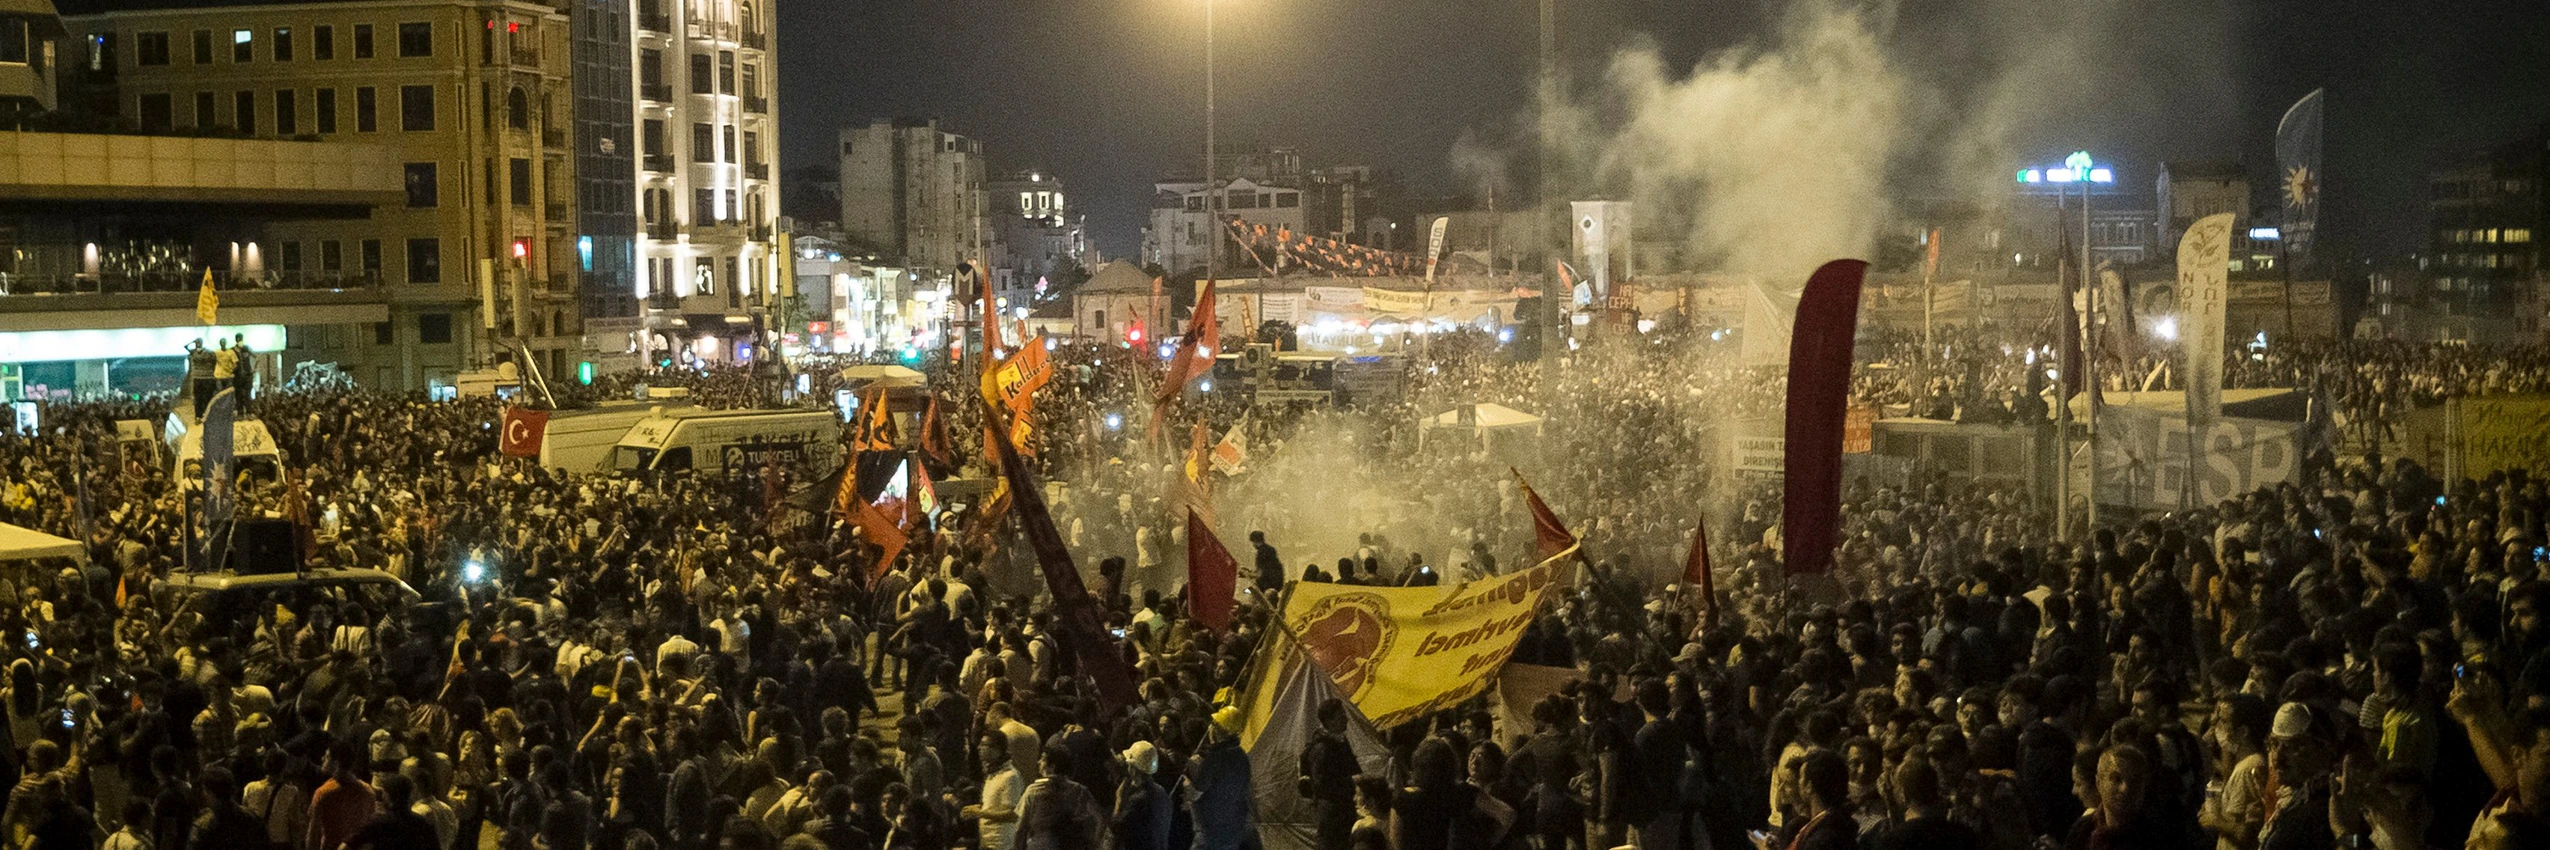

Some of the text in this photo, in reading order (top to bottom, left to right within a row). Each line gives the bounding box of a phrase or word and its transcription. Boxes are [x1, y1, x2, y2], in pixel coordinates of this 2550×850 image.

[954, 268, 974, 295] M
[2180, 271, 2194, 311] NOR
[2153, 416, 2294, 505] ESP
